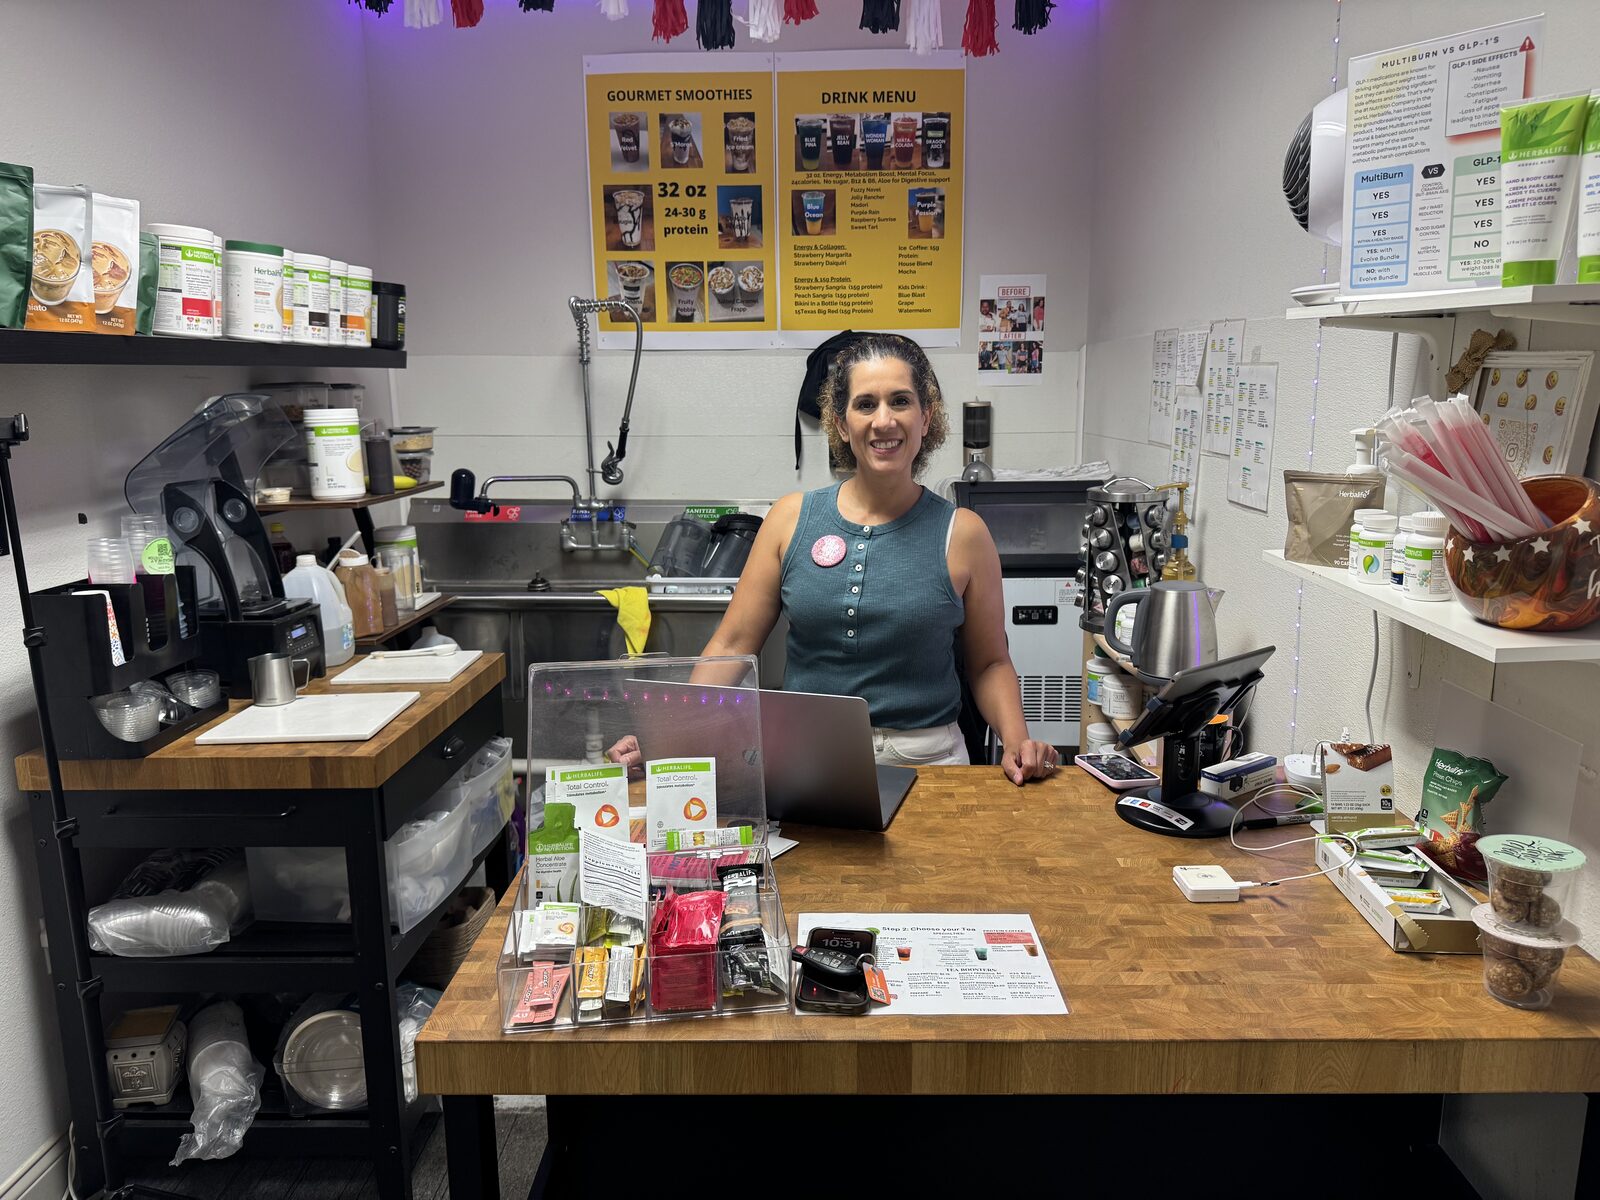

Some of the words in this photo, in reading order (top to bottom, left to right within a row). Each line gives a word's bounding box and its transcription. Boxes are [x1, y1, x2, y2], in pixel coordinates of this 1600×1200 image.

[1382, 50, 1438, 69] MULTIBURN
[1442, 46, 1455, 55] VS
[1459, 36, 1500, 52] GLP-1'S
[1452, 61, 1471, 69] GLP-1
[1472, 57, 1487, 65] SIDE
[1488, 50, 1518, 61] EFFECTS
[608, 90, 672, 102] GOURMET
[676, 89, 752, 101] SMOOTHIES
[822, 92, 868, 104] DRINK
[873, 91, 916, 103] MENU
[1451, 116, 1473, 124] leading
[1470, 120, 1497, 128] nutrition
[1520, 146, 1568, 158] HERBALIFE
[1428, 167, 1439, 175] VS
[901, 177, 928, 185] Digestive
[1361, 171, 1404, 183] MultiBurn
[1477, 177, 1496, 186] YES
[658, 183, 680, 197] 32
[686, 185, 706, 197] oz
[1373, 192, 1390, 200] YES
[1475, 198, 1494, 207] YES
[665, 208, 696, 218] 24-30
[699, 209, 706, 219] g
[1372, 211, 1389, 220] YES
[1474, 220, 1493, 228] YES
[664, 225, 708, 238] protein
[1474, 240, 1490, 248] NO
[1002, 288, 1027, 296] BEFORE
[1339, 490, 1368, 499] Herbalife
[1435, 759, 1464, 775] Herbalife
[657, 775, 671, 783] Total
[1445, 776, 1463, 786] Chips
[584, 855, 622, 870] Supplement
[624, 867, 641, 876] Facts
[823, 939, 860, 949] 10:31
